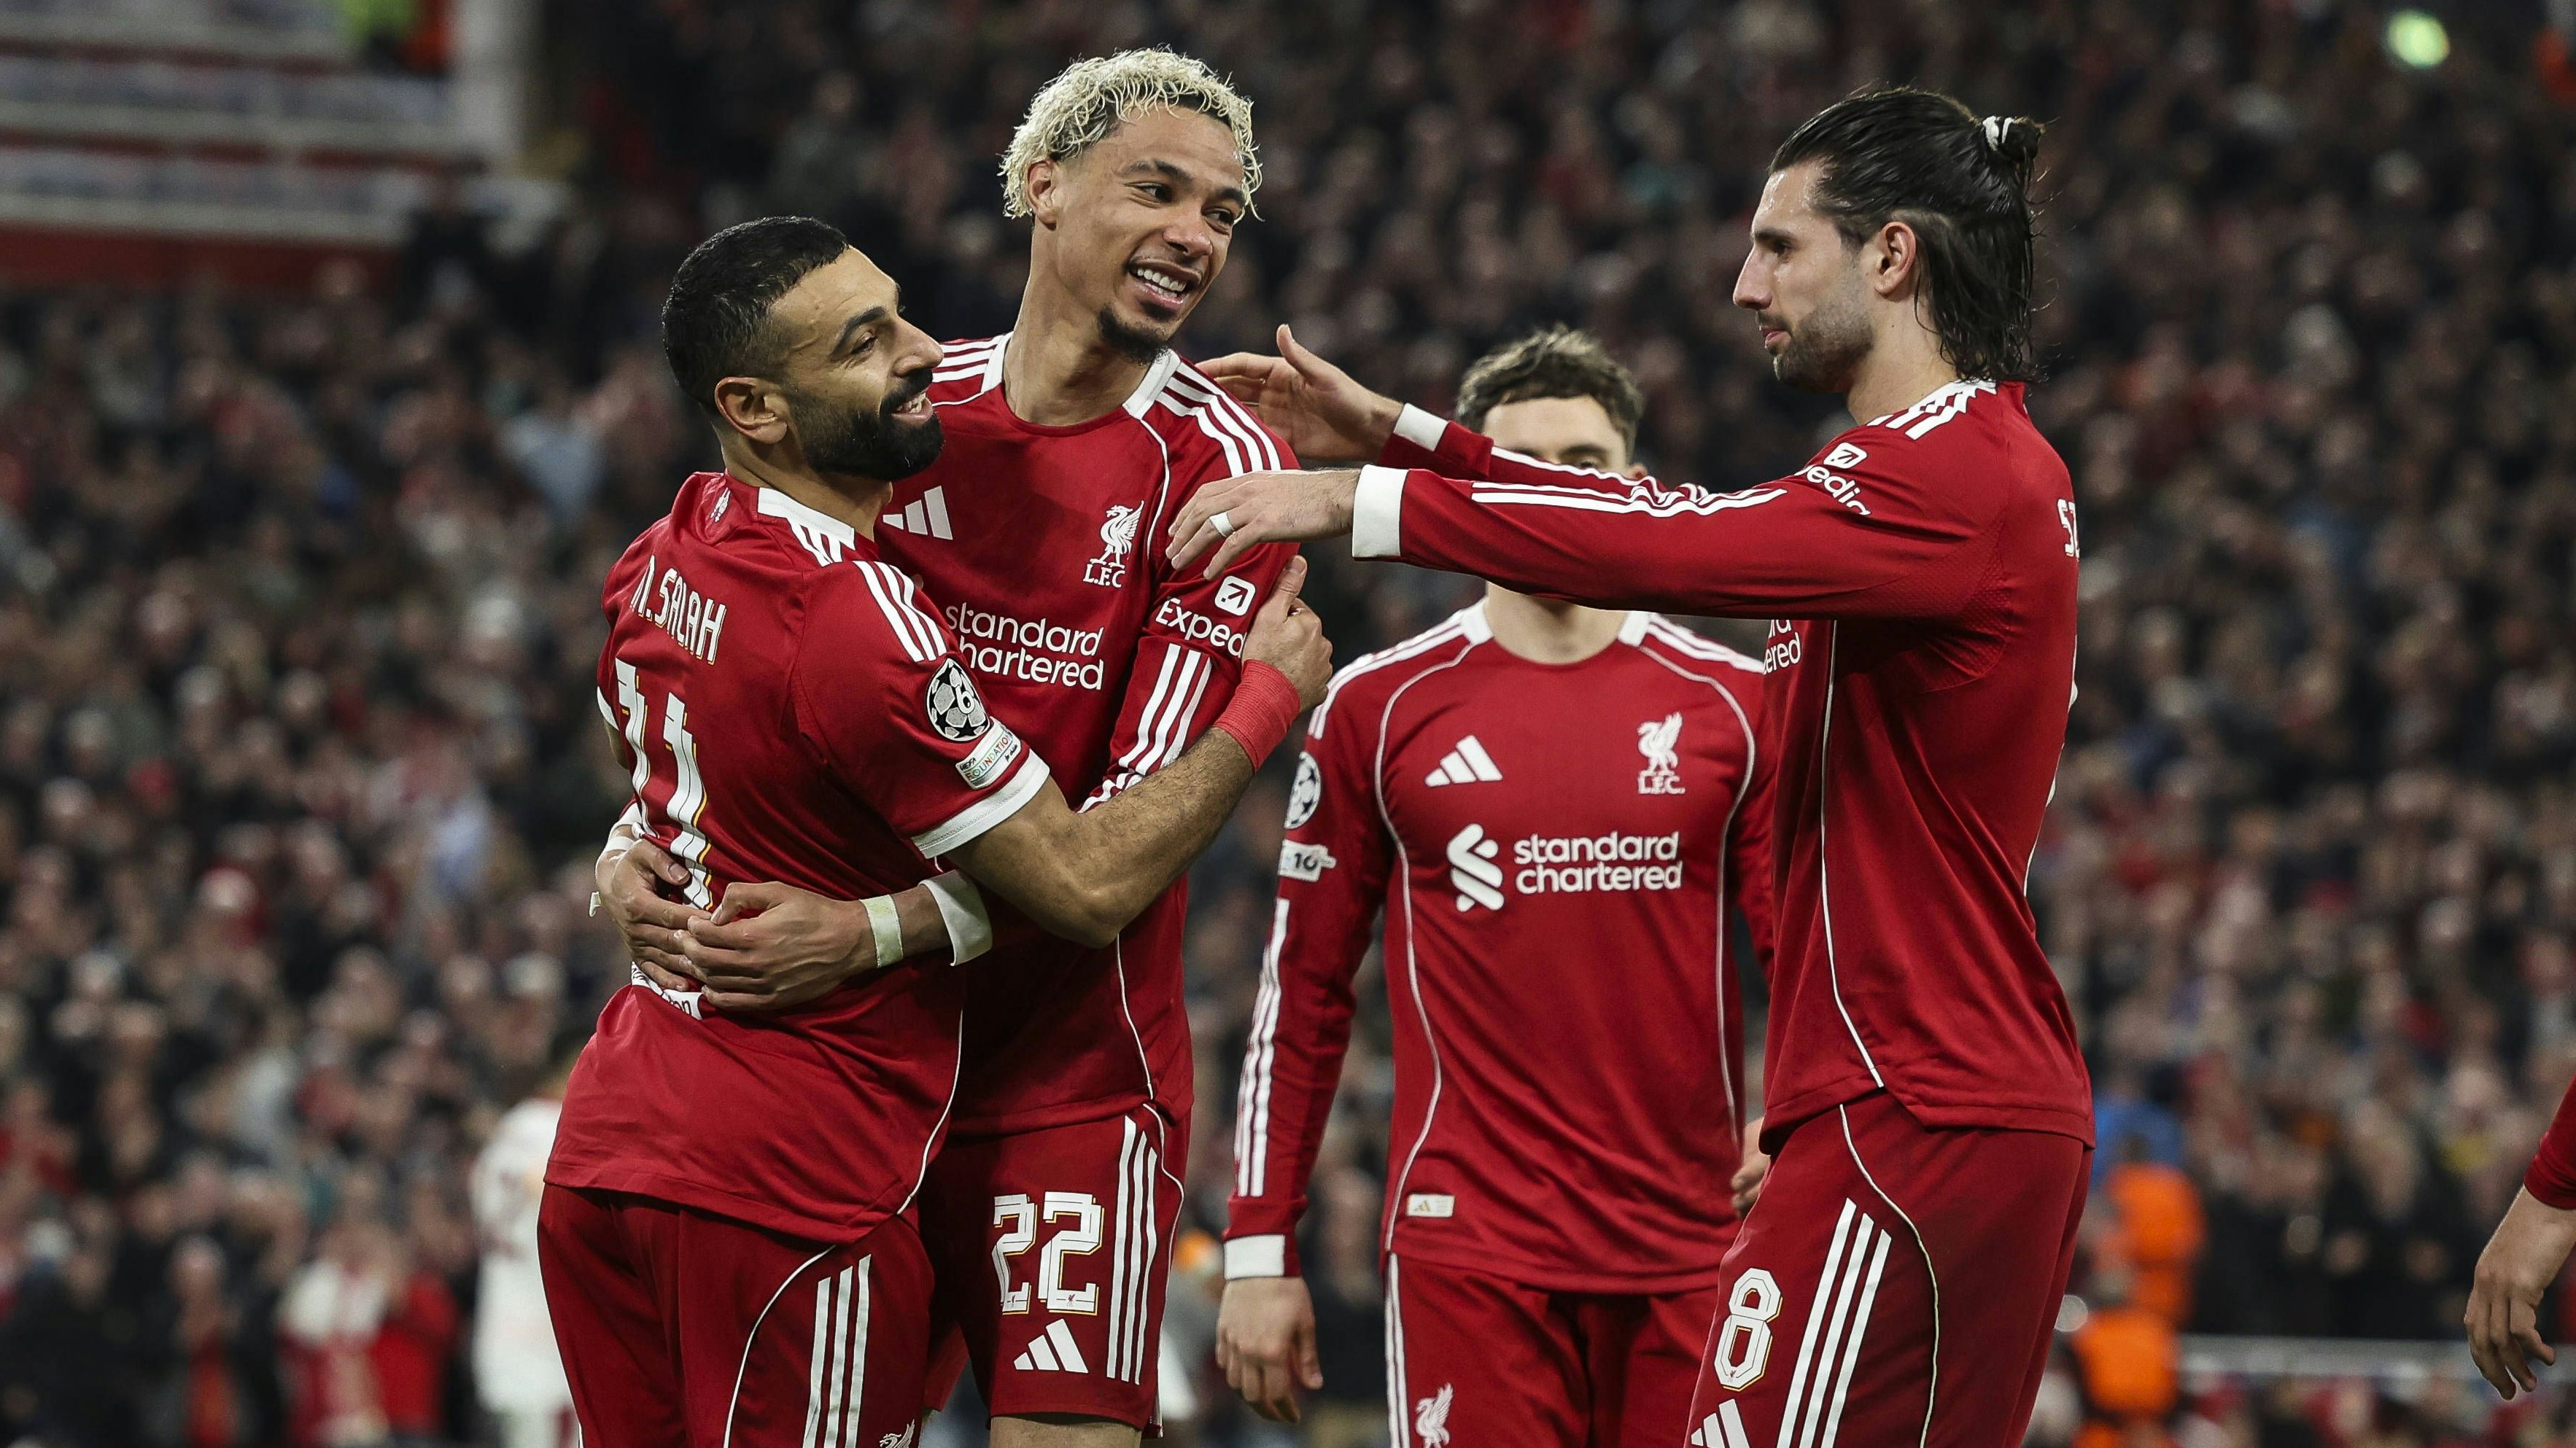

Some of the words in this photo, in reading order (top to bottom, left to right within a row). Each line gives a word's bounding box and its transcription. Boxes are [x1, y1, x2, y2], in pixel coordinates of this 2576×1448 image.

[945, 602, 1104, 656] standard
[1155, 598, 1246, 658] Exped
[960, 635, 1104, 690] hartered
[955, 684, 975, 714] 6
[1513, 830, 1679, 865] standard
[1516, 860, 1683, 895] chartered
[991, 1191, 1105, 1316] 22
[1714, 1267, 1783, 1392] 8
